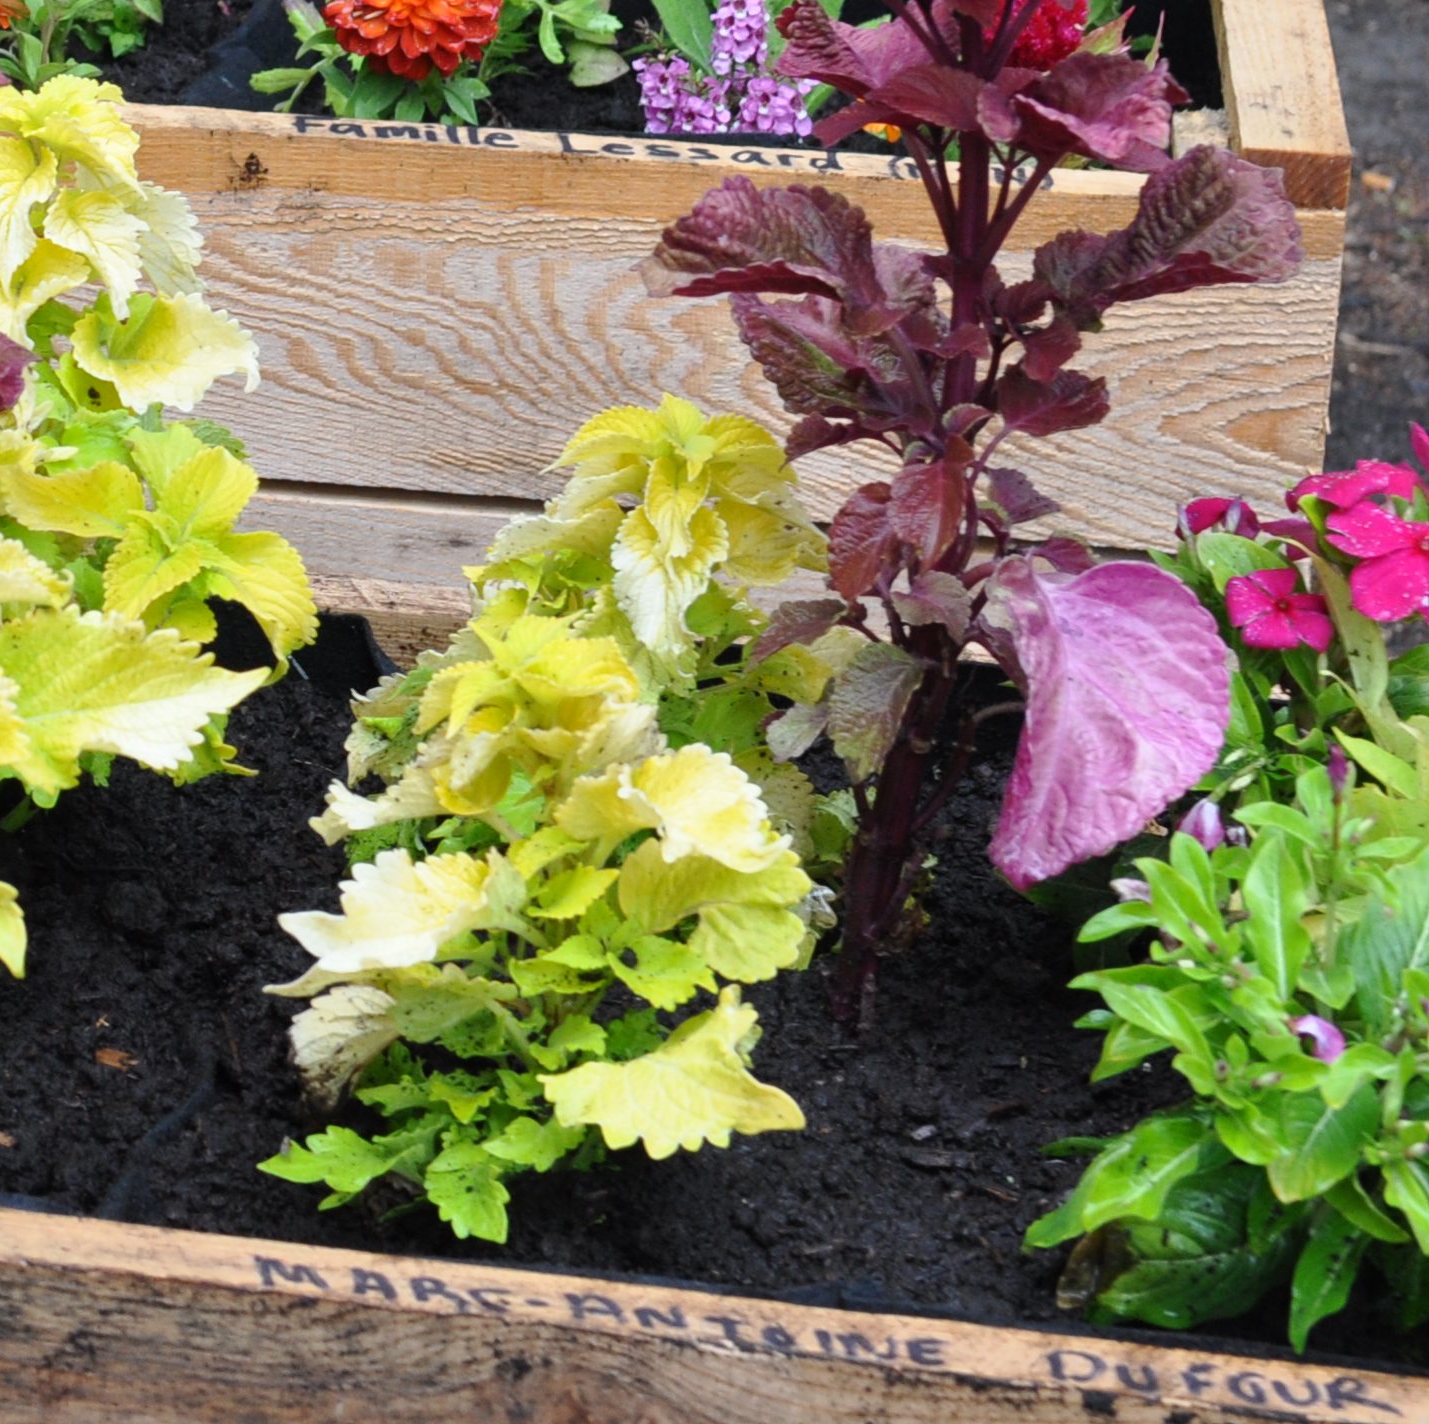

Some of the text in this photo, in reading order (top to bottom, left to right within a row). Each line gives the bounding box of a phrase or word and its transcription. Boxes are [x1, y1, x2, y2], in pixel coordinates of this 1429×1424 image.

[292, 115, 520, 149] Famille
[557, 132, 844, 172] Lessard
[254, 1255, 947, 1366] MARC-ANTOINE
